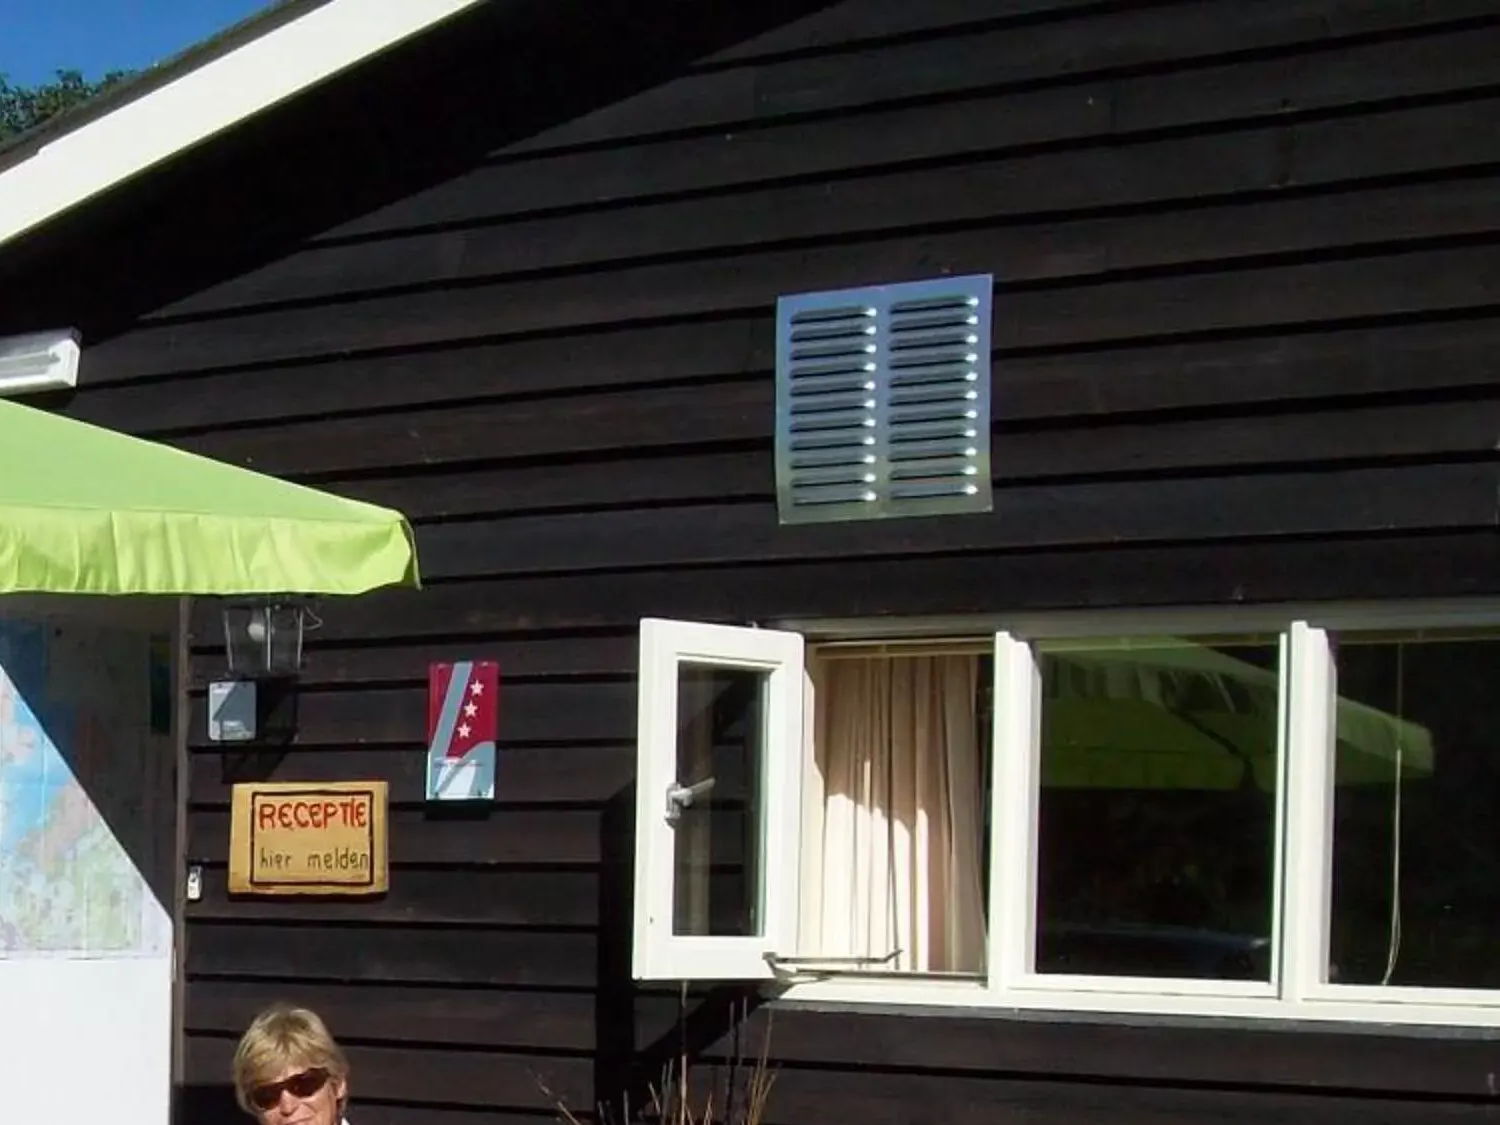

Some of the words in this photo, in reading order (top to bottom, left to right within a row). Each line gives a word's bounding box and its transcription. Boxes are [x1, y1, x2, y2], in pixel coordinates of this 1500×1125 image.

[258, 798, 367, 830] RECEPTIE
[260, 847, 292, 869] hier
[307, 847, 369, 870] melden
